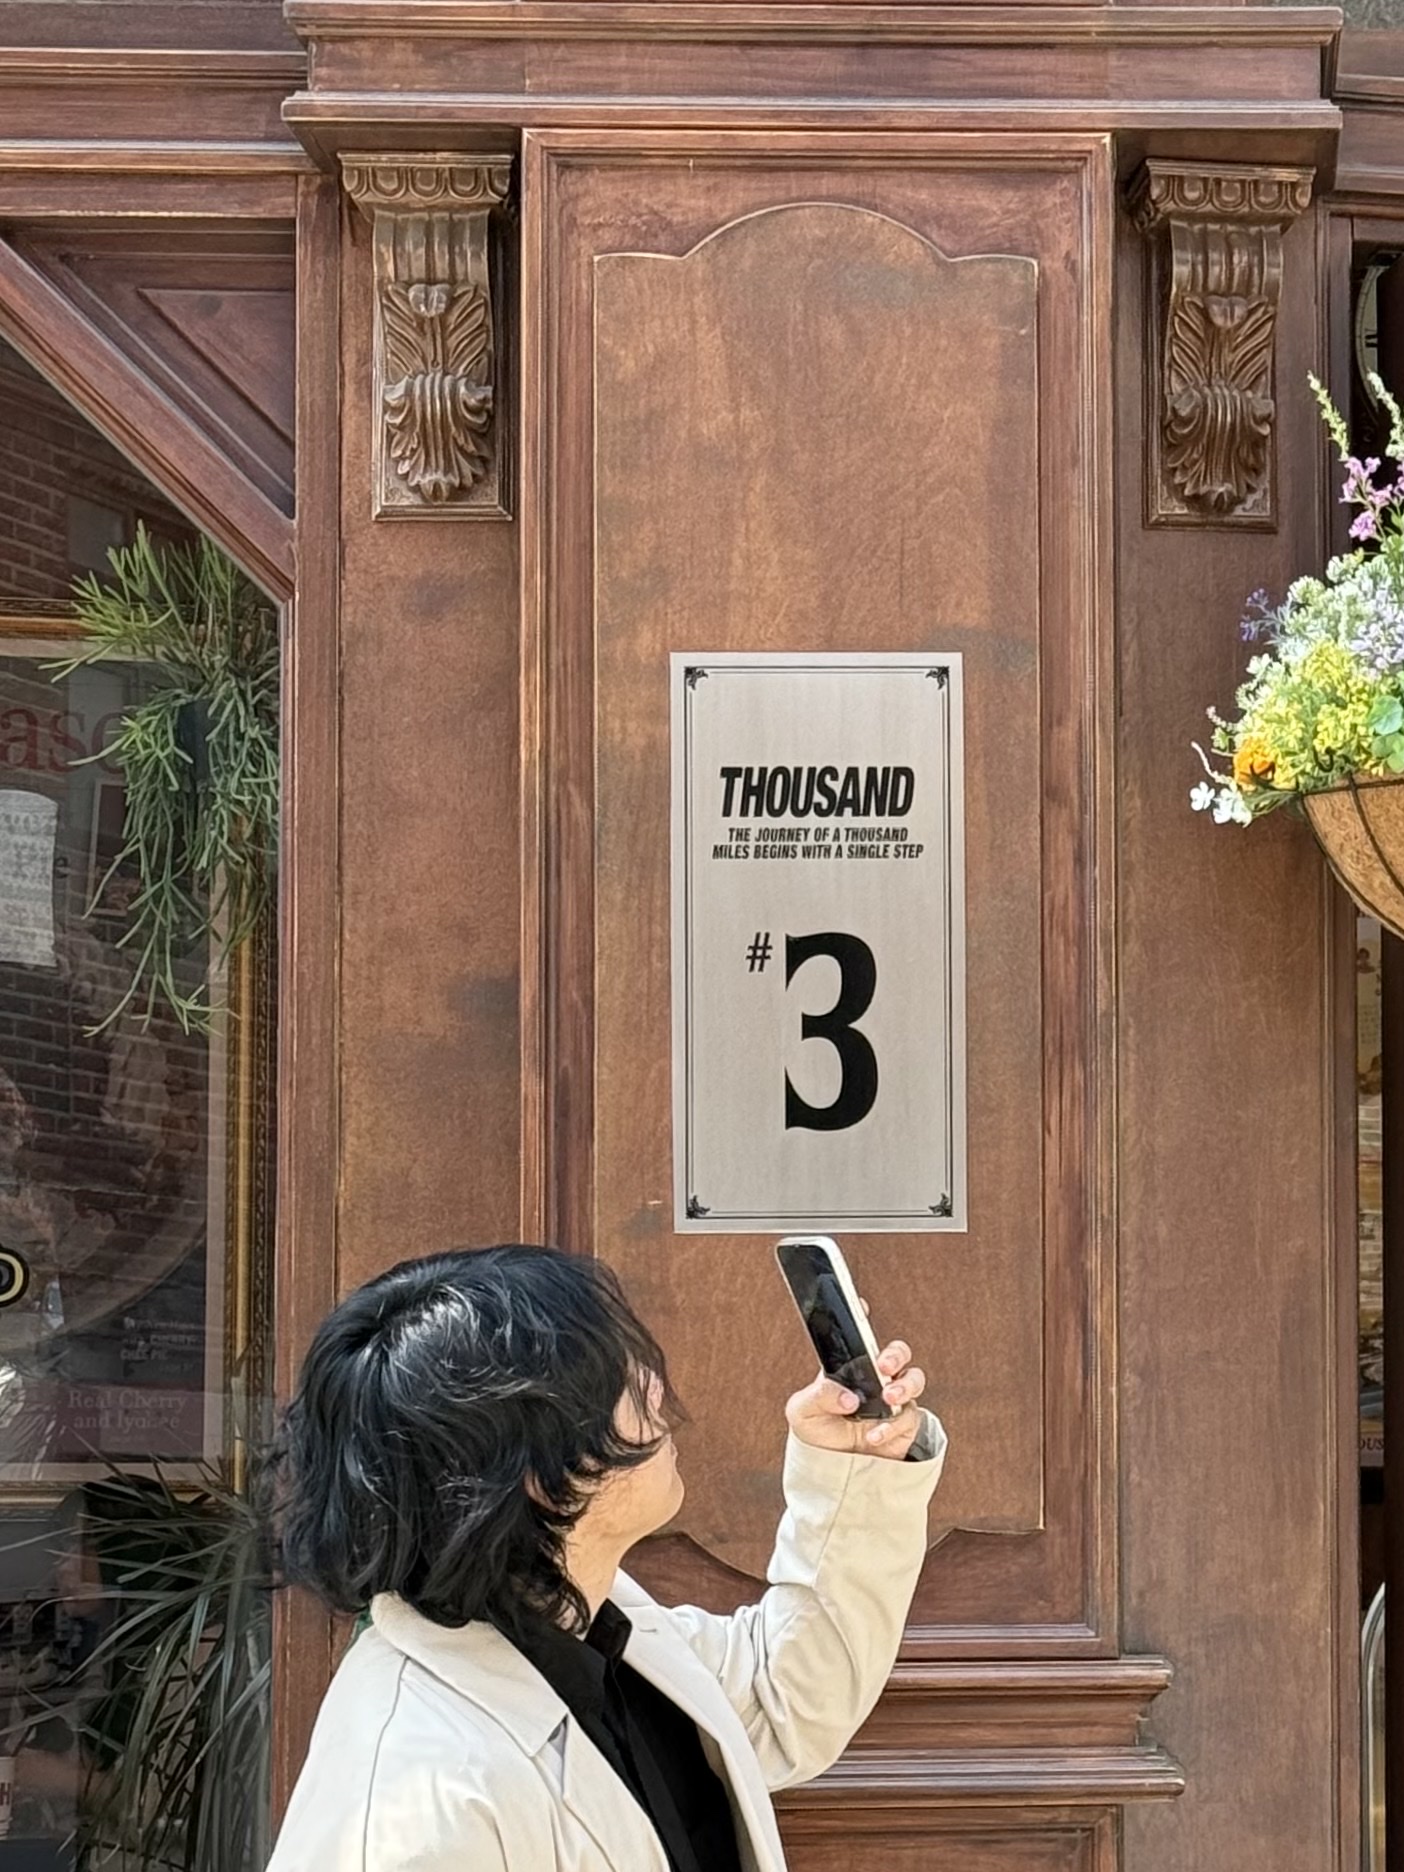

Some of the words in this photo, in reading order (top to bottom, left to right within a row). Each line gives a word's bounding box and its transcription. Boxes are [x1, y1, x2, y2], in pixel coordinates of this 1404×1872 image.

[720, 766, 915, 819] THOUSAND
[728, 827, 751, 843] THE
[754, 827, 810, 843] JOURNEY
[813, 827, 830, 843] OF
[832, 827, 842, 842] A
[844, 827, 909, 843] THOUSAND
[712, 844, 750, 860] MILES
[753, 844, 798, 860] BEGINS
[801, 844, 832, 860] WITH
[834, 845, 844, 860] A
[846, 844, 890, 860] SINGLE
[893, 844, 924, 860] STEP
[68, 1390, 112, 1408] Real
[119, 1390, 187, 1415] Cherry
[74, 1411, 113, 1428] and
